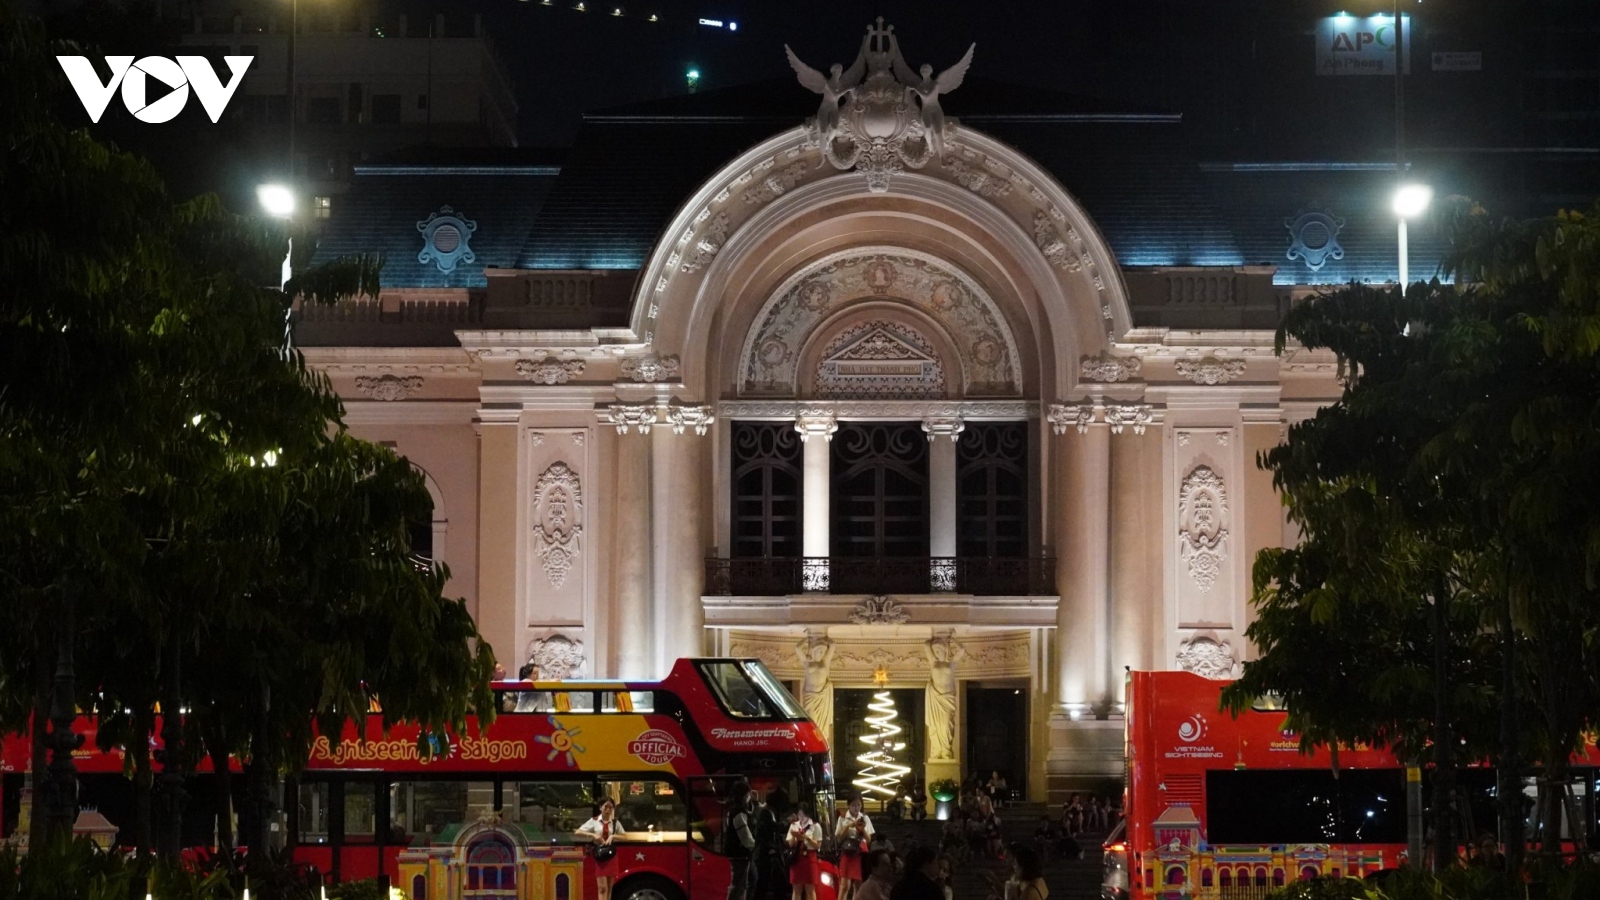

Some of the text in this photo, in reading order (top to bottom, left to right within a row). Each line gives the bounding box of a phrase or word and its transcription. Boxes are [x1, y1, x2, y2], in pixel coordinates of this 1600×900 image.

[711, 727, 796, 739] Vietnamtourism
[459, 735, 527, 764] Saigon
[633, 742, 683, 756] OFFICIAL
[646, 754, 669, 763] TOUR
